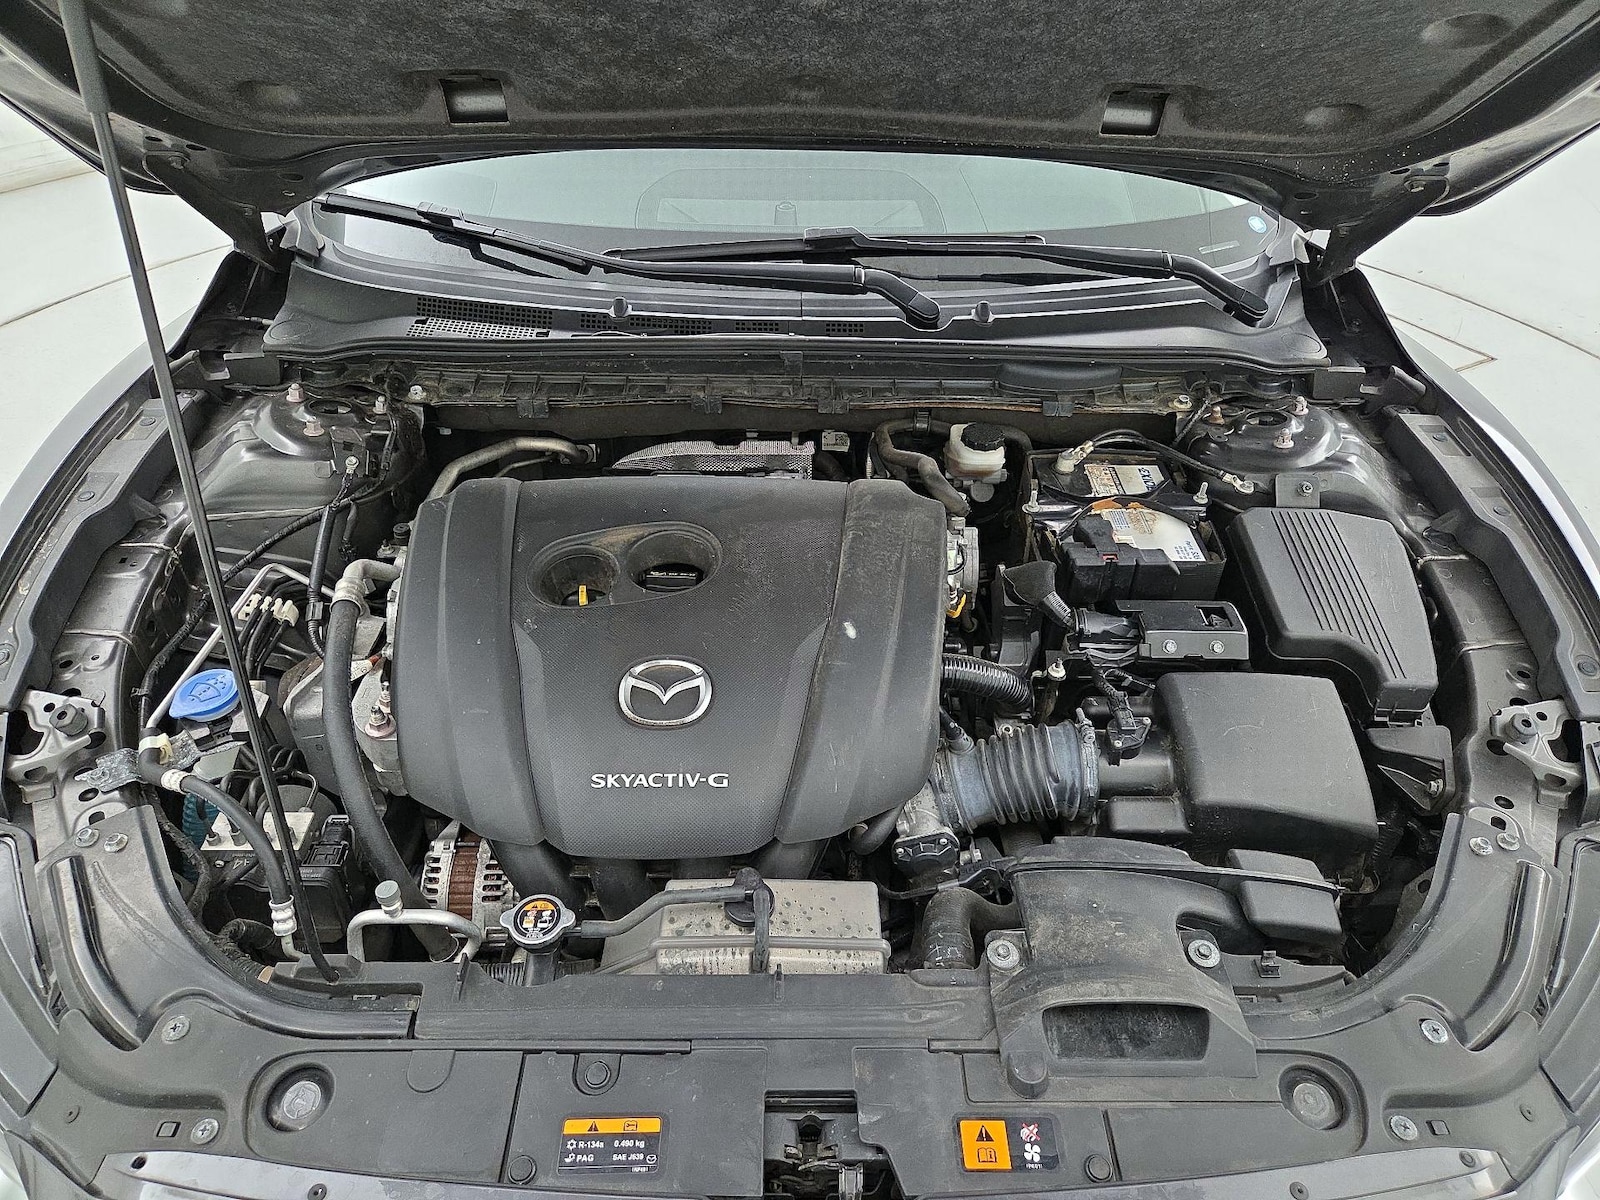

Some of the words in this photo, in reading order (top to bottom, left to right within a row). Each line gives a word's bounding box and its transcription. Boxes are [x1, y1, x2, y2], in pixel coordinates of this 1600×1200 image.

[591, 772, 729, 788] SKYACTIV-G
[578, 1140, 604, 1149] R-134a
[614, 1140, 635, 1148] 0.490
[635, 1139, 645, 1149] kg
[576, 1154, 594, 1163] PAG
[612, 1153, 627, 1161] SAE
